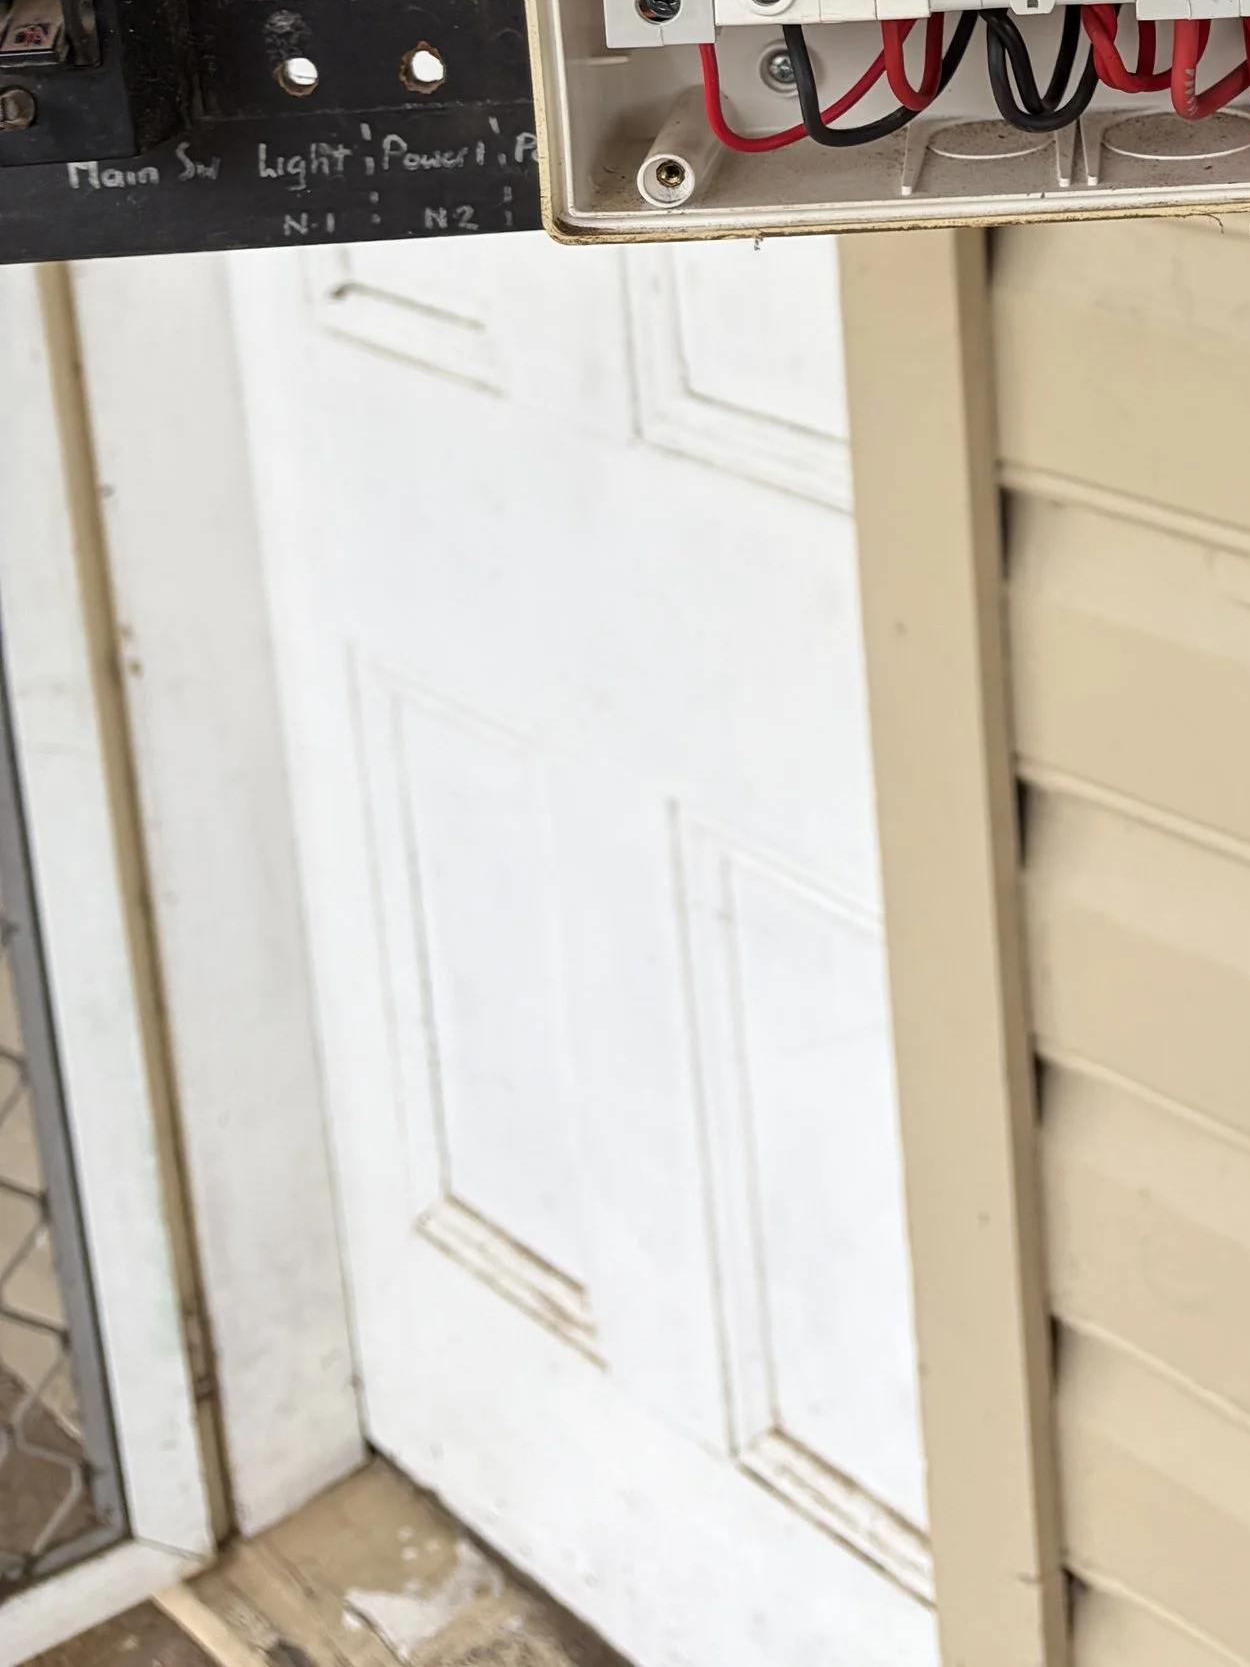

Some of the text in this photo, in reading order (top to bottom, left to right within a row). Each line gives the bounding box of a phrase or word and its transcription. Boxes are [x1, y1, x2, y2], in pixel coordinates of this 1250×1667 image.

[65, 160, 160, 190] Main
[257, 140, 353, 192] Light
[381, 133, 468, 172] Power
